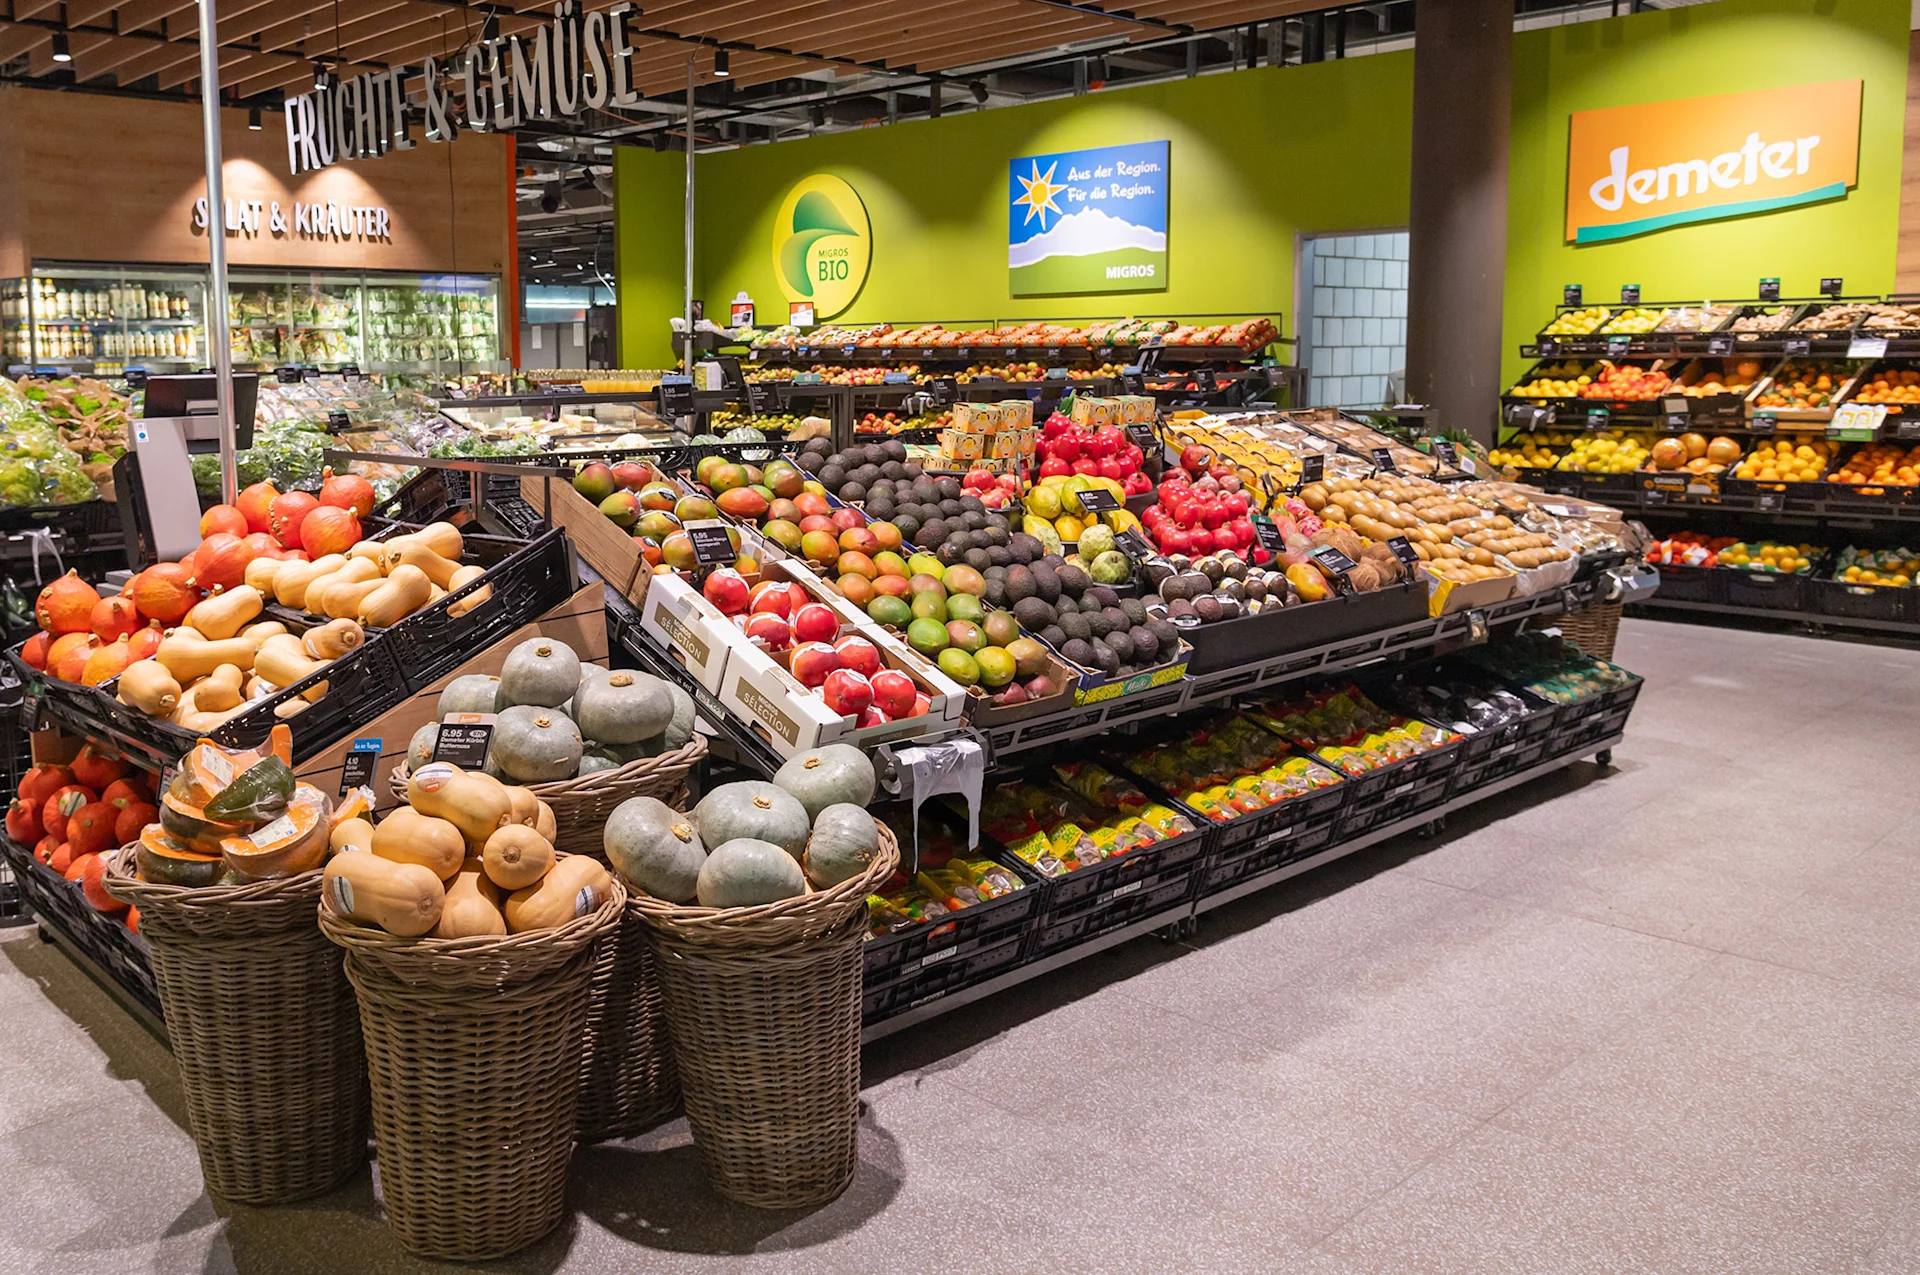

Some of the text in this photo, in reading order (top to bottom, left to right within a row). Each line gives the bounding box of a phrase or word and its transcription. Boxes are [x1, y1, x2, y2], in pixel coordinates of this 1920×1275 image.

[284, 0, 638, 175] FRÜCHTE & GEMÜSE
[1067, 161, 1161, 181] Aus der Region.
[1589, 132, 1821, 211] demeter
[1067, 183, 1155, 202] Für die Region.
[194, 197, 390, 237] SLAT & KRÄUTER
[818, 248, 849, 258] MIGROS
[818, 259, 849, 281] BIO
[1105, 265, 1155, 279] MIGROS
[660, 616, 702, 660] SÉLECTION
[674, 618, 692, 638] MIGROS
[743, 692, 790, 738] SÉLECTION
[758, 695, 779, 716] MIGROS
[442, 729, 463, 737] 6.95
